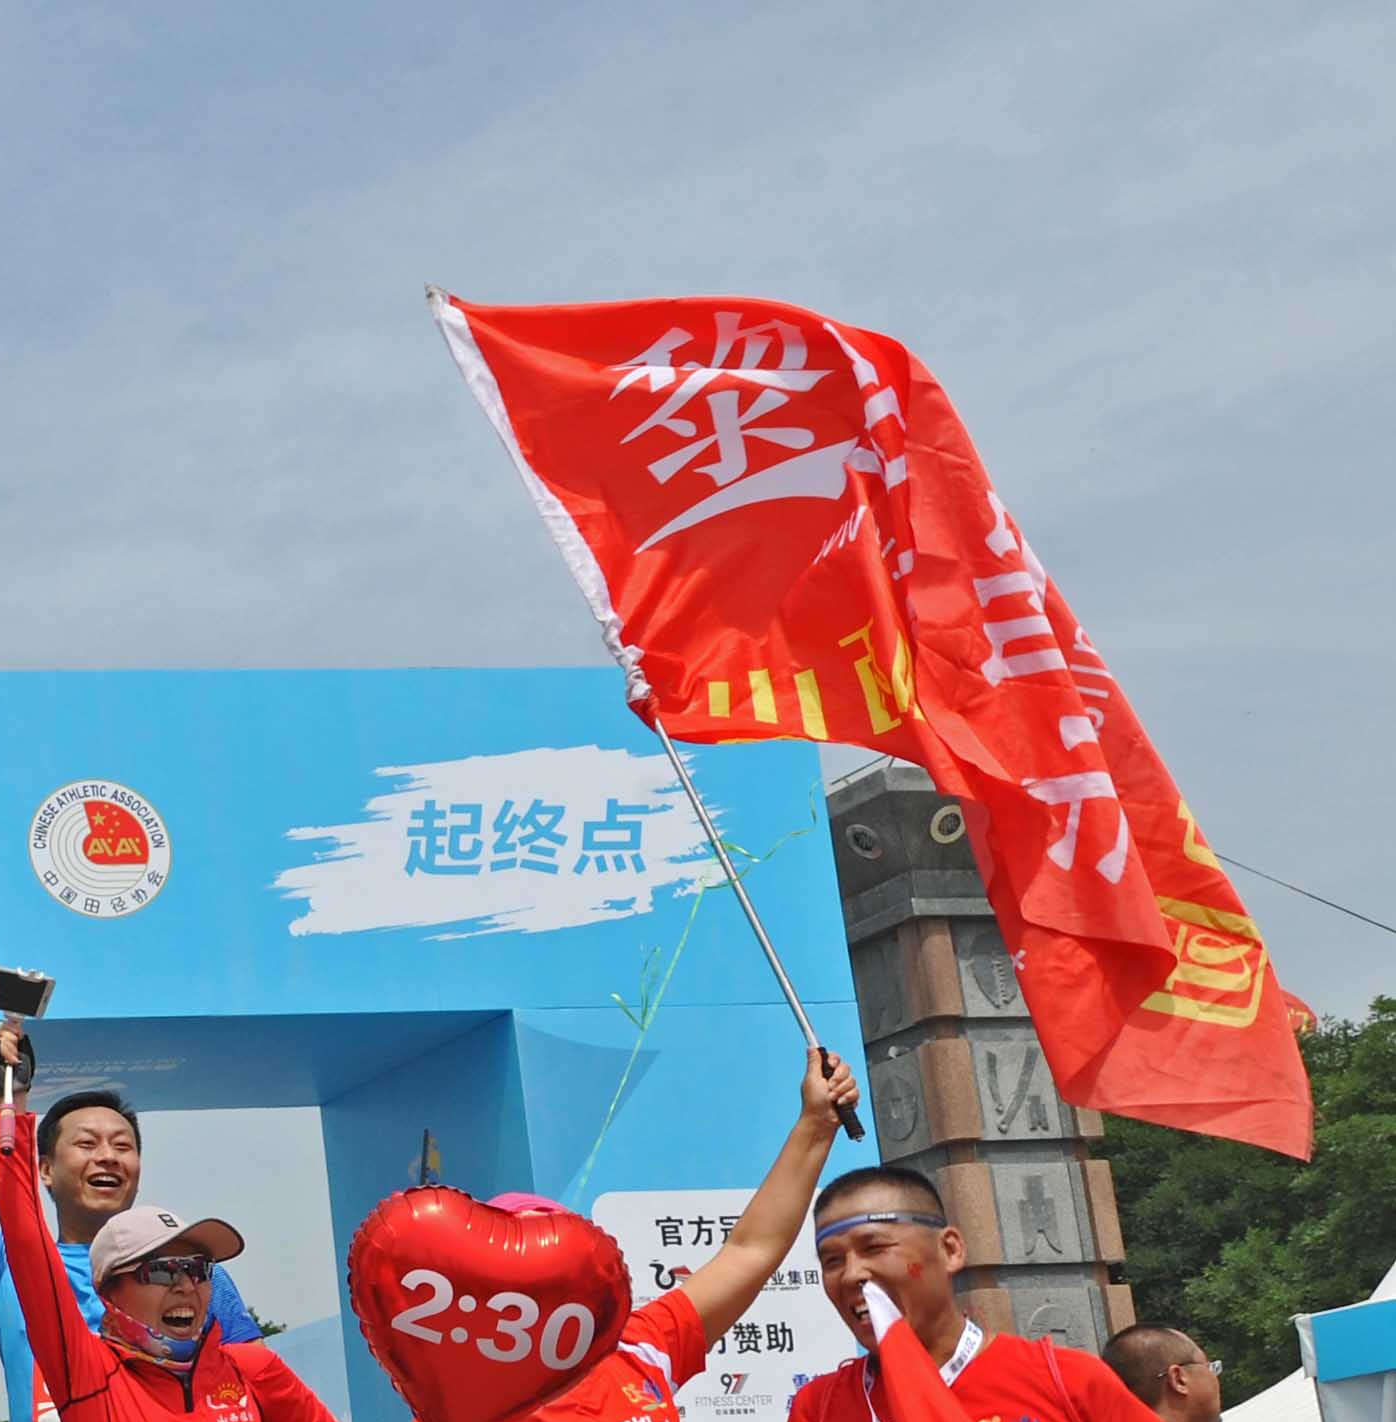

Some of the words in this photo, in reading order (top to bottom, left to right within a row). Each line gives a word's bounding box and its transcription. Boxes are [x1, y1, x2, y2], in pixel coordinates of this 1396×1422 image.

[33, 803, 59, 849] CHINESE
[56, 785, 107, 811] ATHLETIC
[110, 790, 165, 848] ASSOCIATION
[404, 798, 649, 877] 起终点
[43, 870, 164, 914] 中国田径协会
[391, 1268, 595, 1371] 2:30
[695, 1395, 735, 1407] FITNESS
[737, 1394, 773, 1406] CENTER
